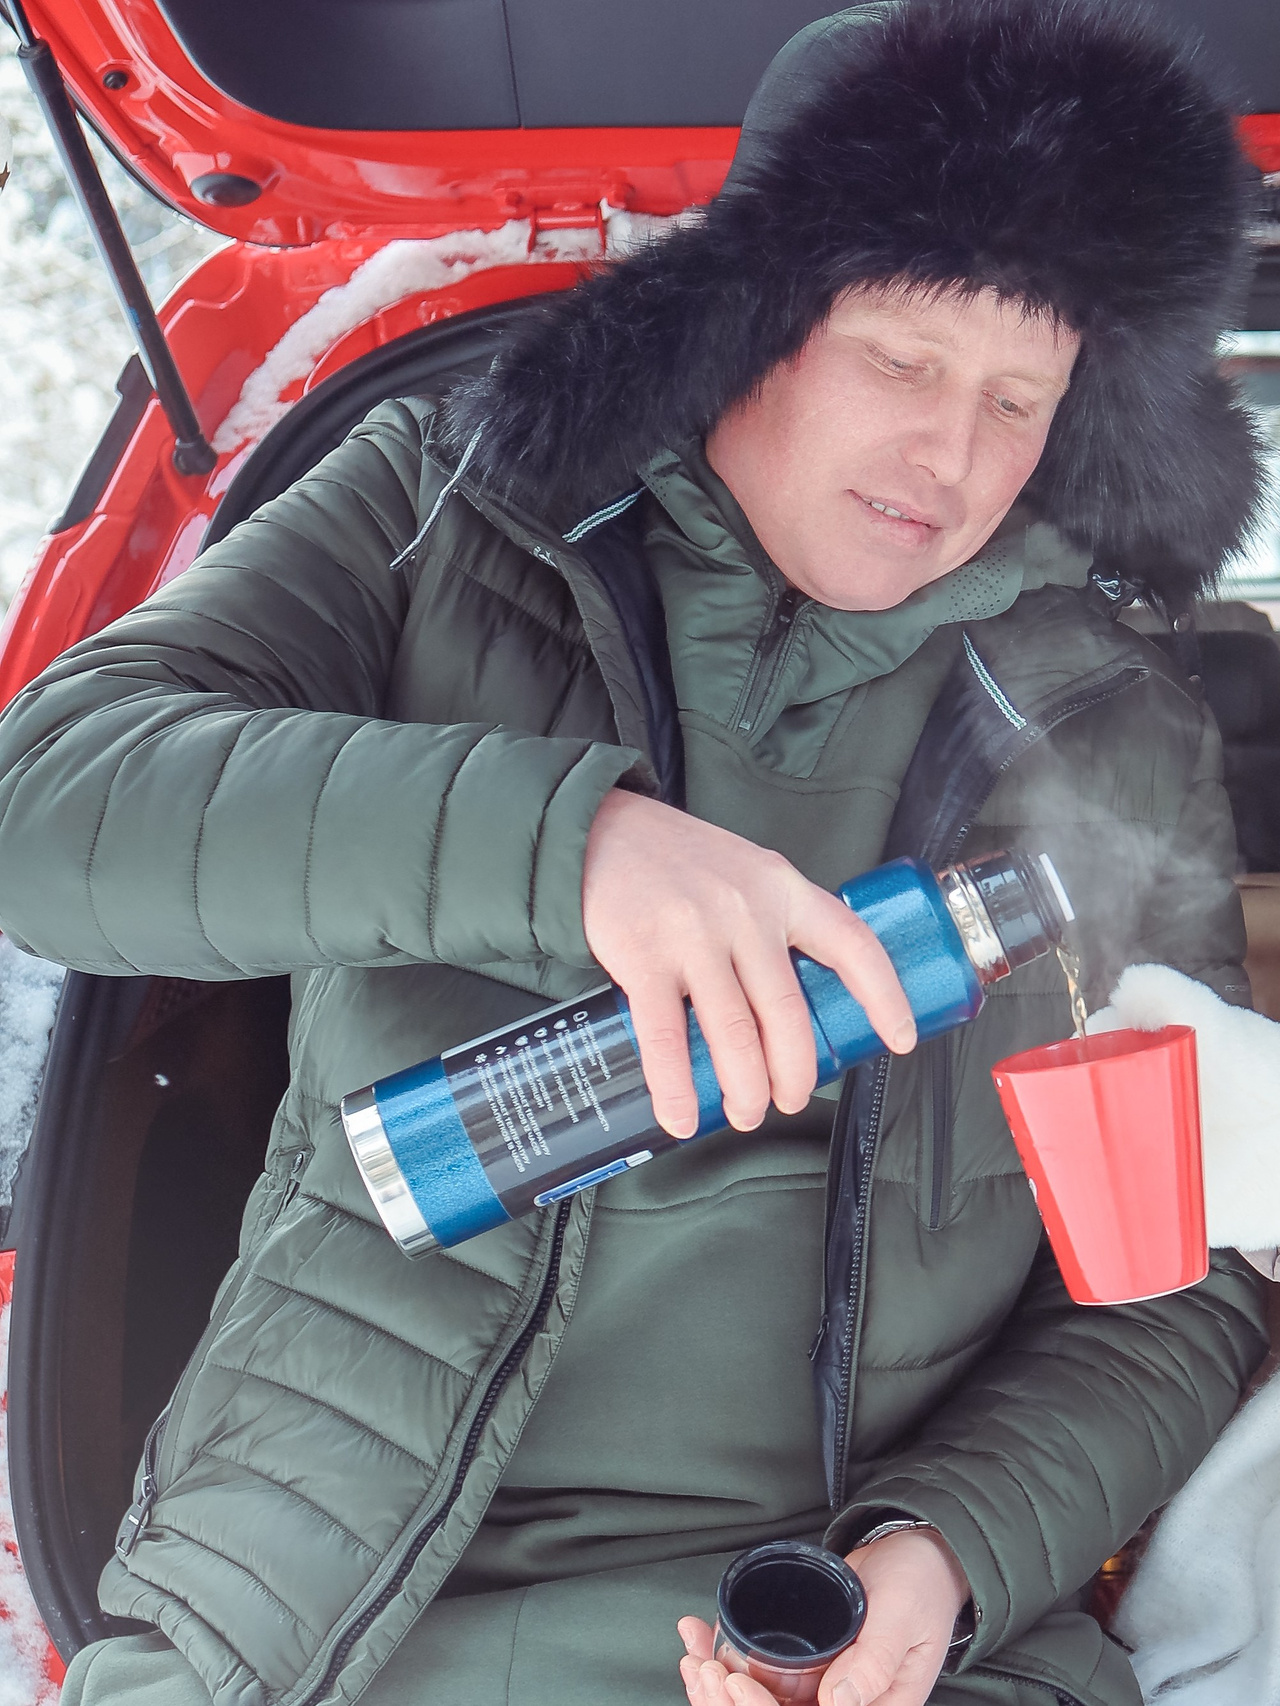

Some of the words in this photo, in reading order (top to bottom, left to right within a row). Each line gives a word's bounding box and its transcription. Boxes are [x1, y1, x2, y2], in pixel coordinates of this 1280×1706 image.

[496, 1057, 510, 1085] ГОРЯЧИХ
[506, 1085, 527, 1125] НАПИТКОВ
[526, 1131, 541, 1156] ЧАСОВ
[504, 1054, 528, 1108] ПОДДЕРЖИВАЕТ
[524, 1108, 551, 1156] ТЕМПЕРАТУРУ
[517, 1049, 544, 1108] ТЕРМОИЗОЛЯЦИИ
[524, 1045, 541, 1077] ВЫСОКИЙ
[535, 1077, 554, 1112] УРОВЕНЬ
[540, 1038, 554, 1065] ЗАЩИТА
[554, 1075, 578, 1123] ПРОТЕКАНИЯ
[555, 1031, 573, 1067] ВНЕШНЕГО
[569, 1067, 590, 1107] ПОКРЫТИЯ
[563, 1028, 586, 1076] ПОВЫШЕННАЯ
[581, 1076, 609, 1131] УСТОЙЧИВОСТЬ
[595, 1050, 611, 1080] ПРОБКА
[476, 1066, 494, 1102] ХОЛОДНЫХ
[489, 1102, 510, 1142] НАПИТКОВ
[510, 1149, 525, 1172] ЧАСОВ
[484, 1062, 508, 1117] ПОДДЕРЖИВАЕТ
[504, 1116, 530, 1165] ТЕМПЕРАТУРУ
